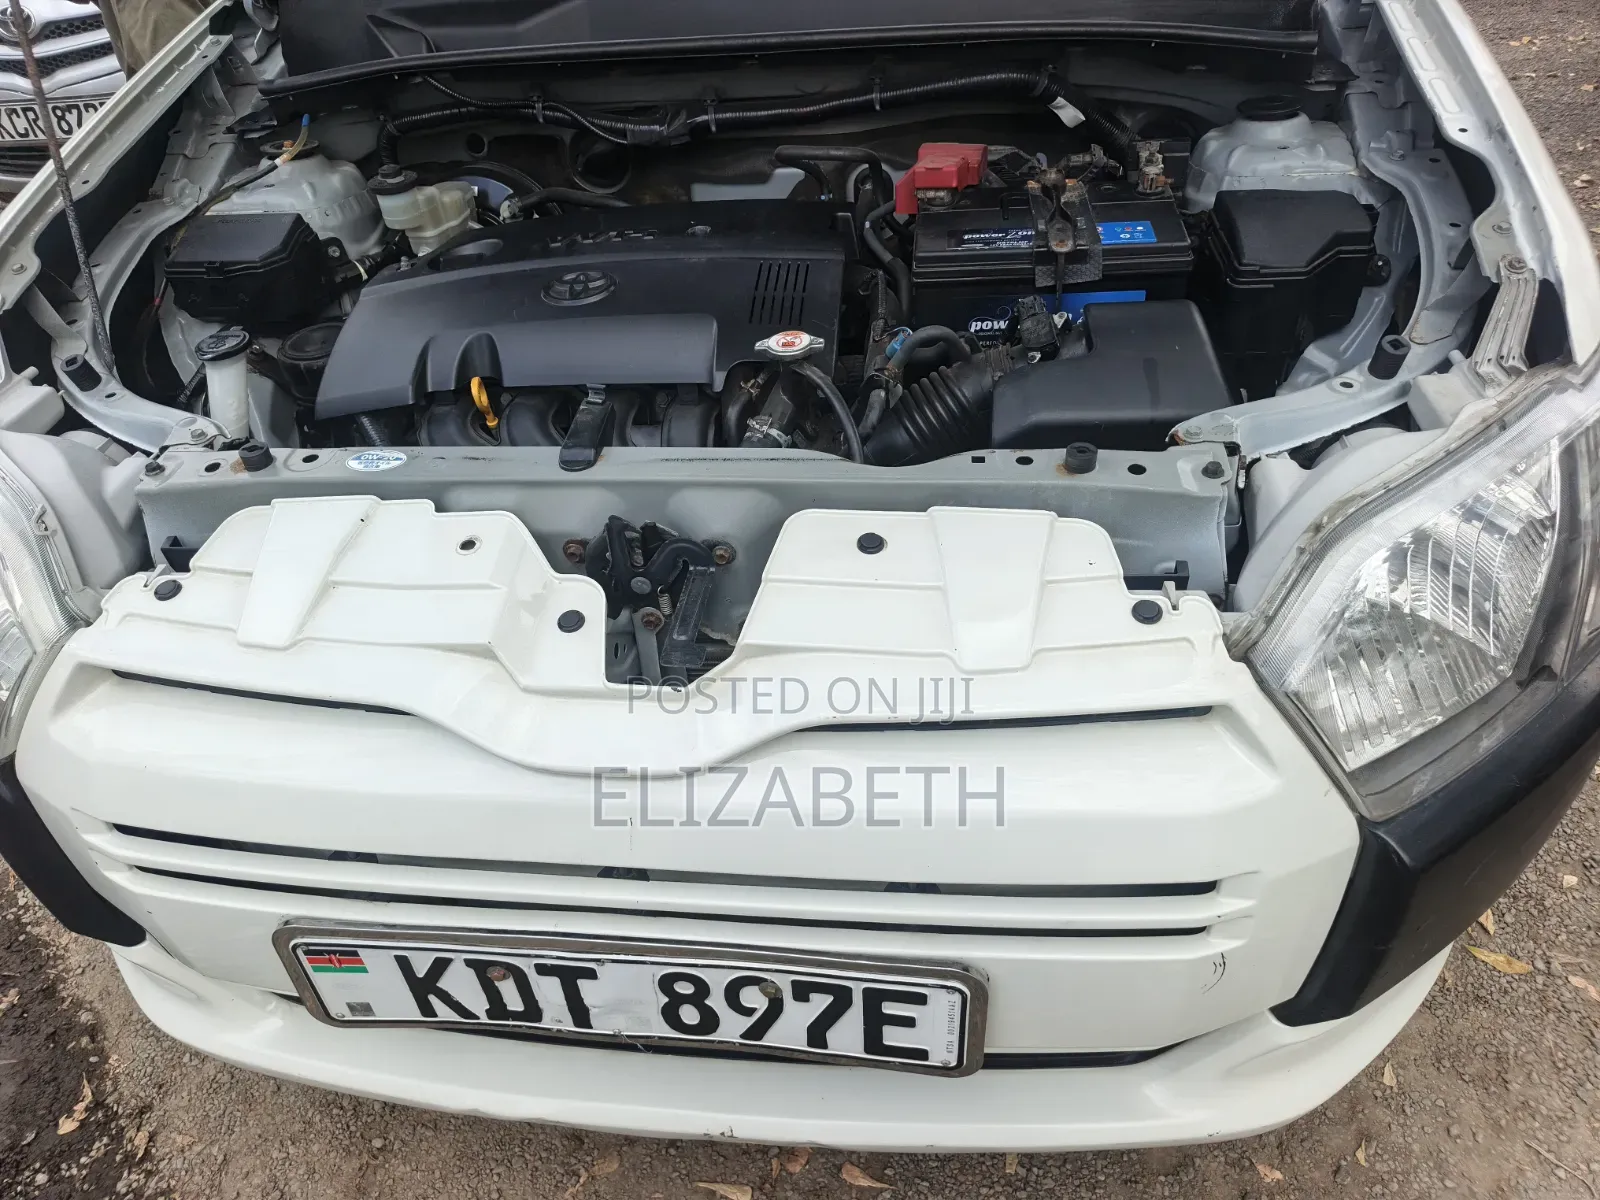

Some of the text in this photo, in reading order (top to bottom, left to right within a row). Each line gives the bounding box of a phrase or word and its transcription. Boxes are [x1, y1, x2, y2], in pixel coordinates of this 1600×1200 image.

[51, 102, 107, 136] 87
[962, 232, 1006, 240] power
[969, 320, 1009, 333] pow
[393, 954, 930, 1062] KDT 897E
